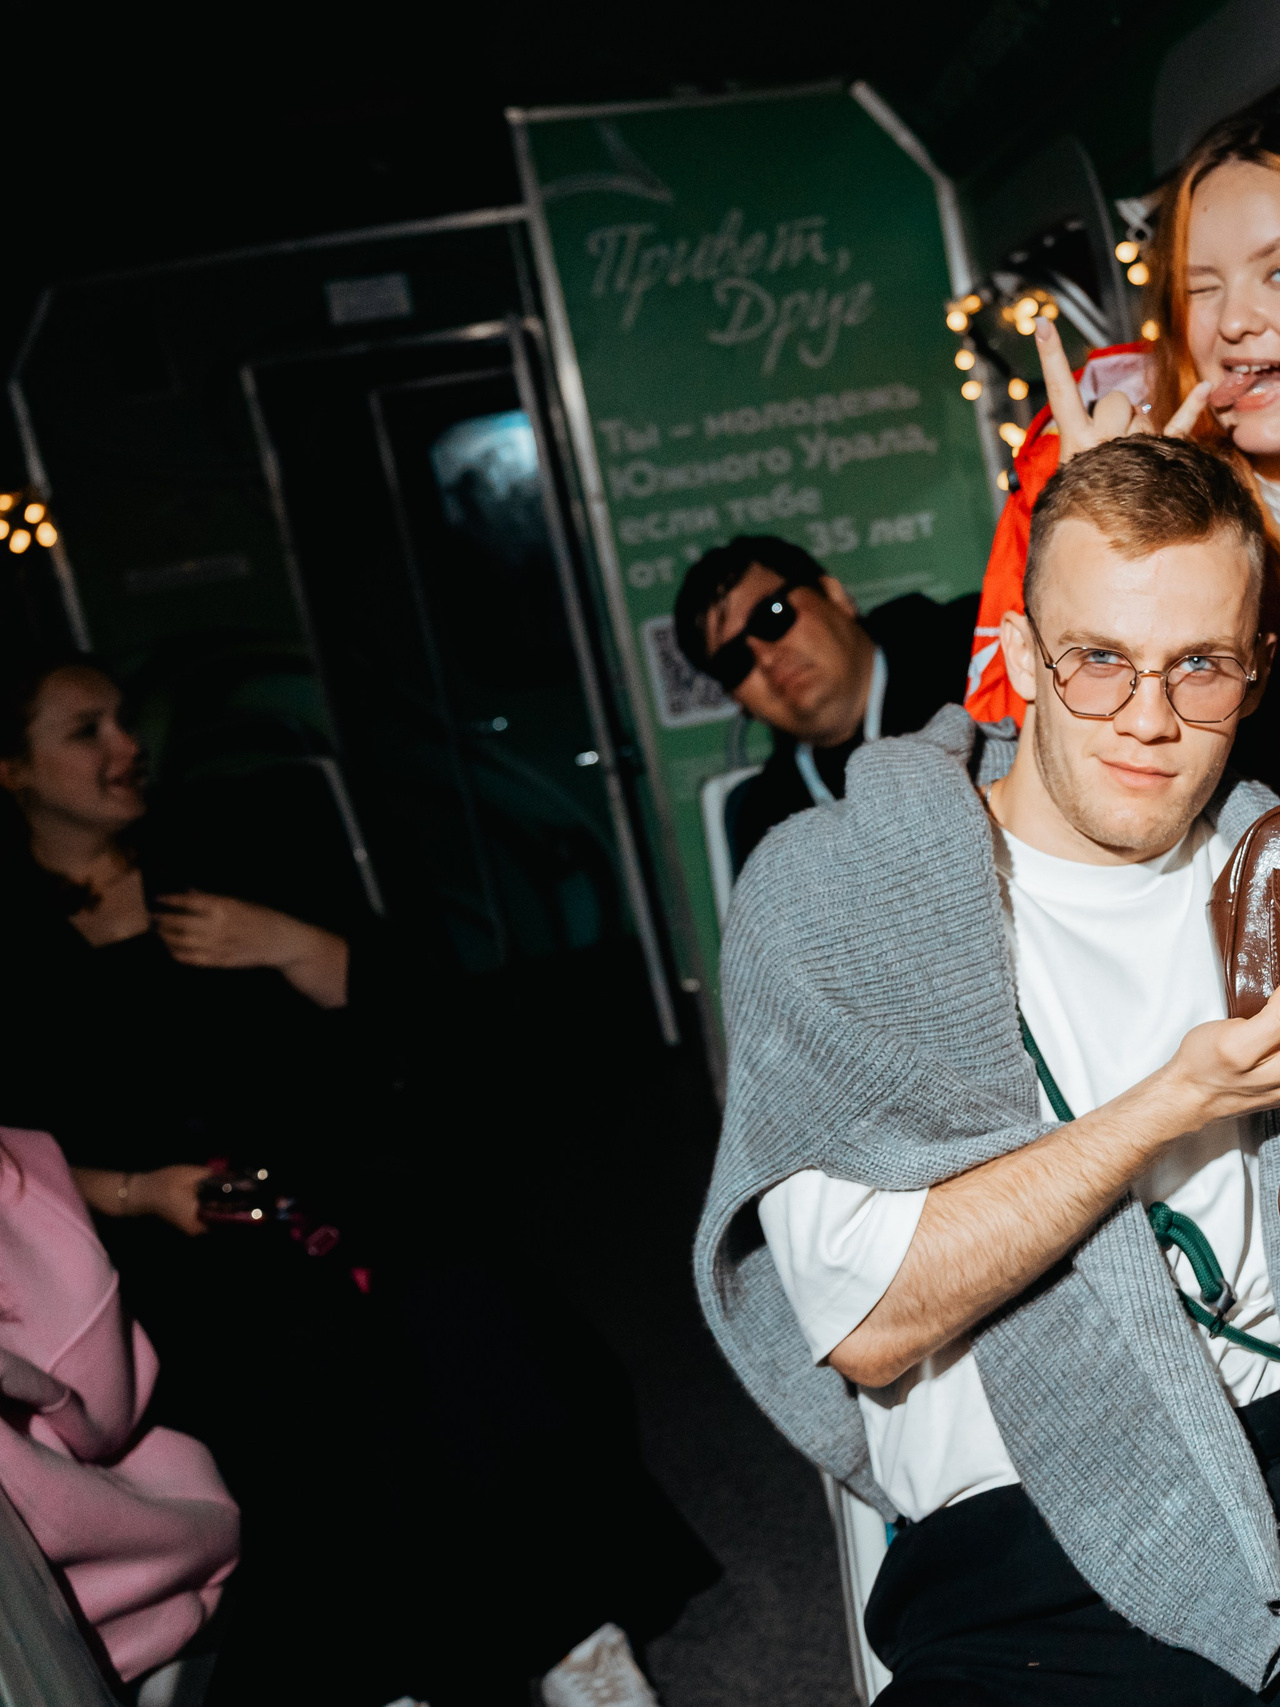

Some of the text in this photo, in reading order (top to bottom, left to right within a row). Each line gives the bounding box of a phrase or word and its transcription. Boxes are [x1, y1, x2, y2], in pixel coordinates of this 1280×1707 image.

[586, 207, 850, 332] Привет,
[708, 277, 875, 376] Друг
[601, 416, 659, 452] Ты
[609, 421, 938, 500] Южного Урала,
[617, 483, 823, 544] если тебе
[628, 512, 935, 589] от 35 лет
